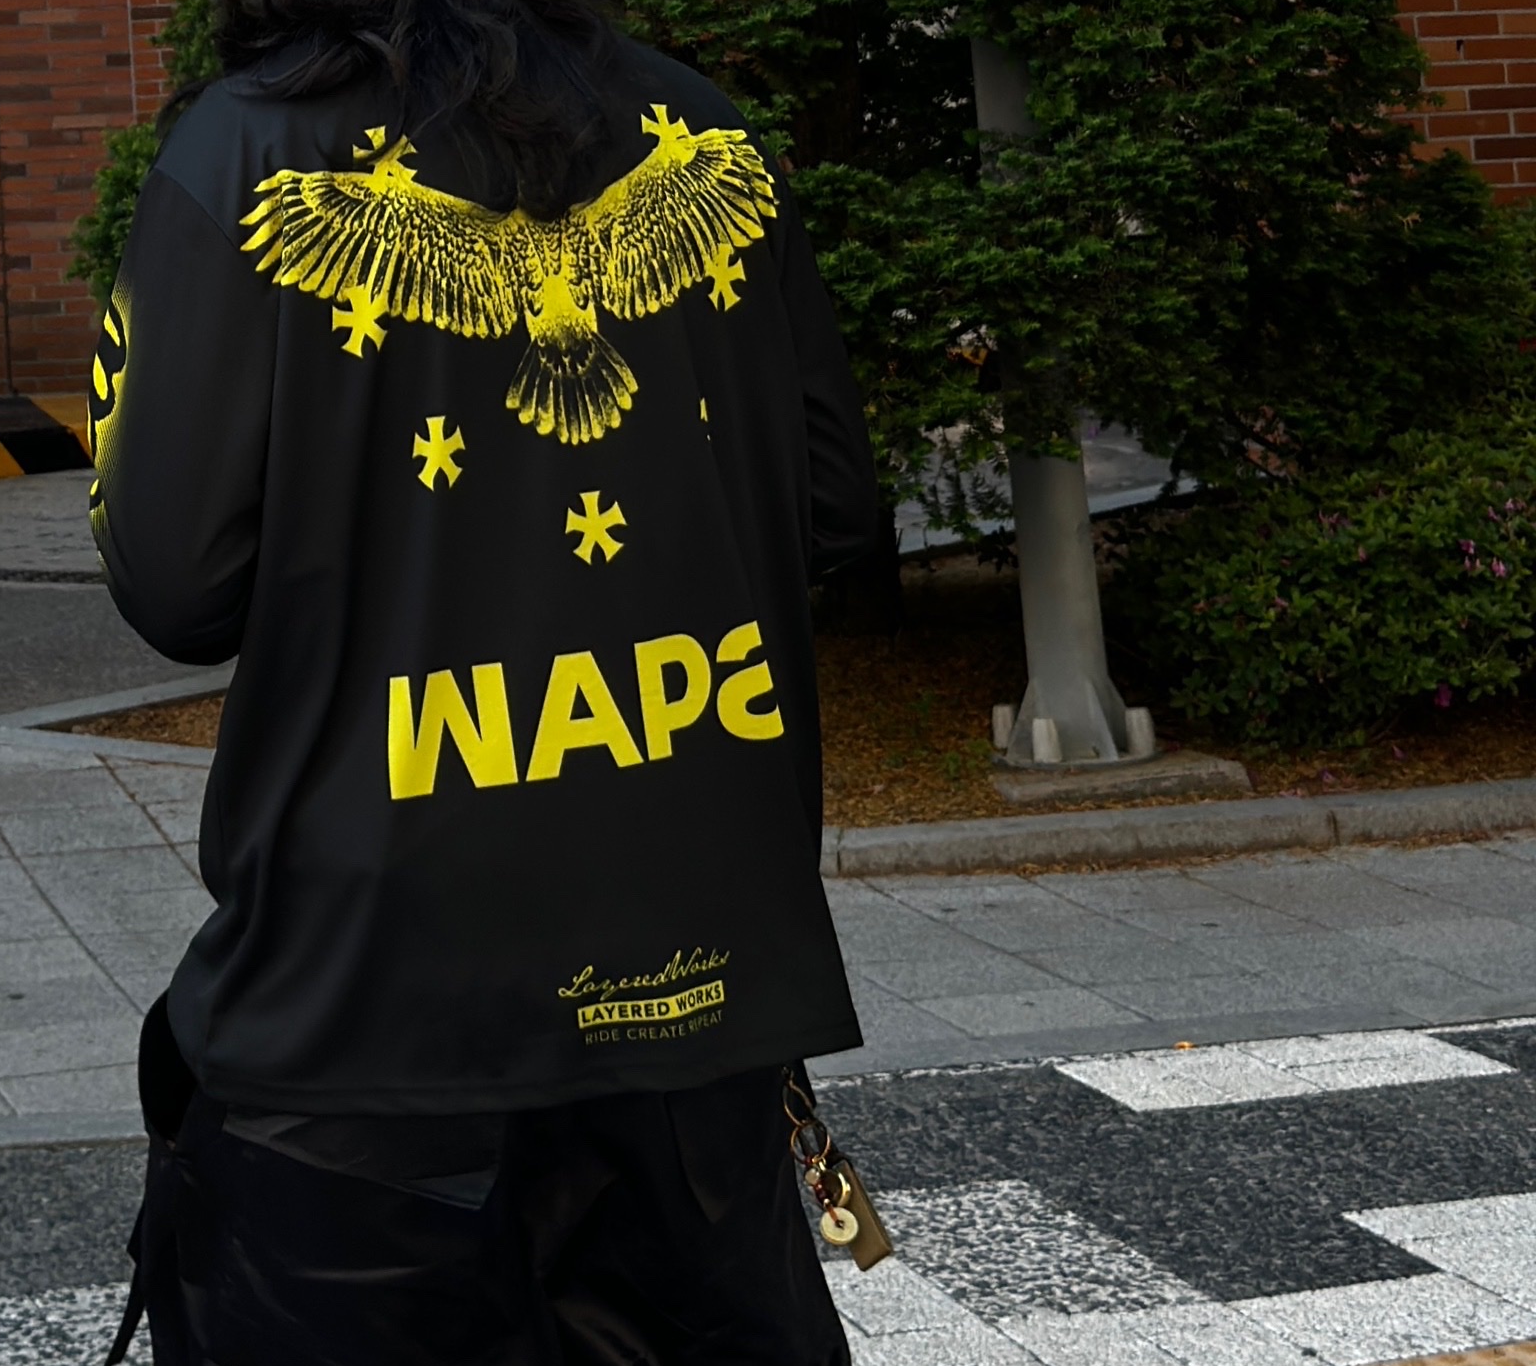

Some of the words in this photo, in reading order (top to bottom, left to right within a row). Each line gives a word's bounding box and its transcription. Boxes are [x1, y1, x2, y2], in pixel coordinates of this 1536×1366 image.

[580, 1001, 670, 1025] LAYERED
[675, 983, 721, 1013] WORKS
[585, 1028, 620, 1046] RIDE
[626, 1023, 686, 1041] CREATE
